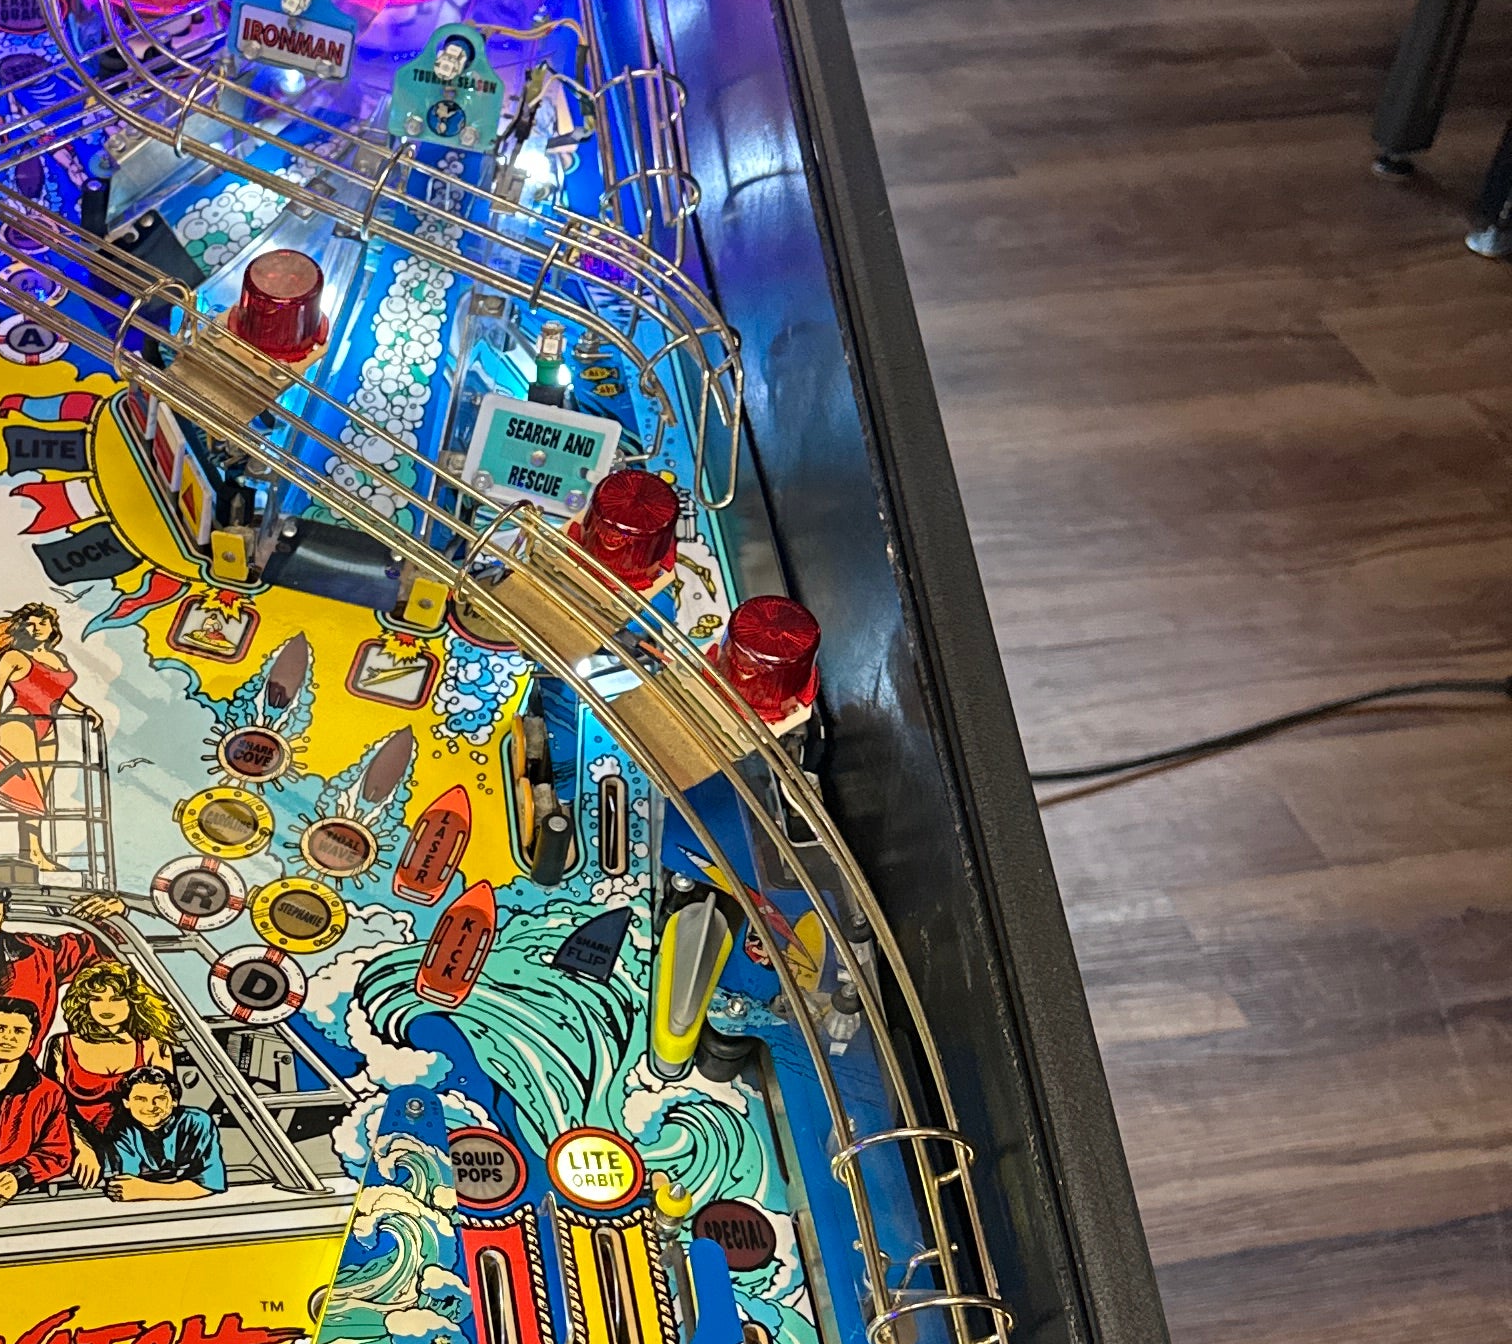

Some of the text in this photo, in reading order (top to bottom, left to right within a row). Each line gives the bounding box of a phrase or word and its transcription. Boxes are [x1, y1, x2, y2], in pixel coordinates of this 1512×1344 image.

[242, 17, 345, 65] IRONMAN
[15, 437, 78, 461] LITE
[506, 417, 596, 458] SEARCH AND
[507, 466, 563, 497] RESCUE
[53, 537, 120, 573] LOCK
[234, 751, 272, 768] COVE
[414, 811, 451, 884] LASER
[277, 901, 325, 928] STEPHANIE
[444, 917, 474, 979] KICK
[451, 1150, 505, 1166] SQUID
[568, 1150, 623, 1171] LITE
[457, 1167, 504, 1184] POPS
[572, 1172, 625, 1189] ORBIT
[703, 1219, 769, 1251] SPECIAL
